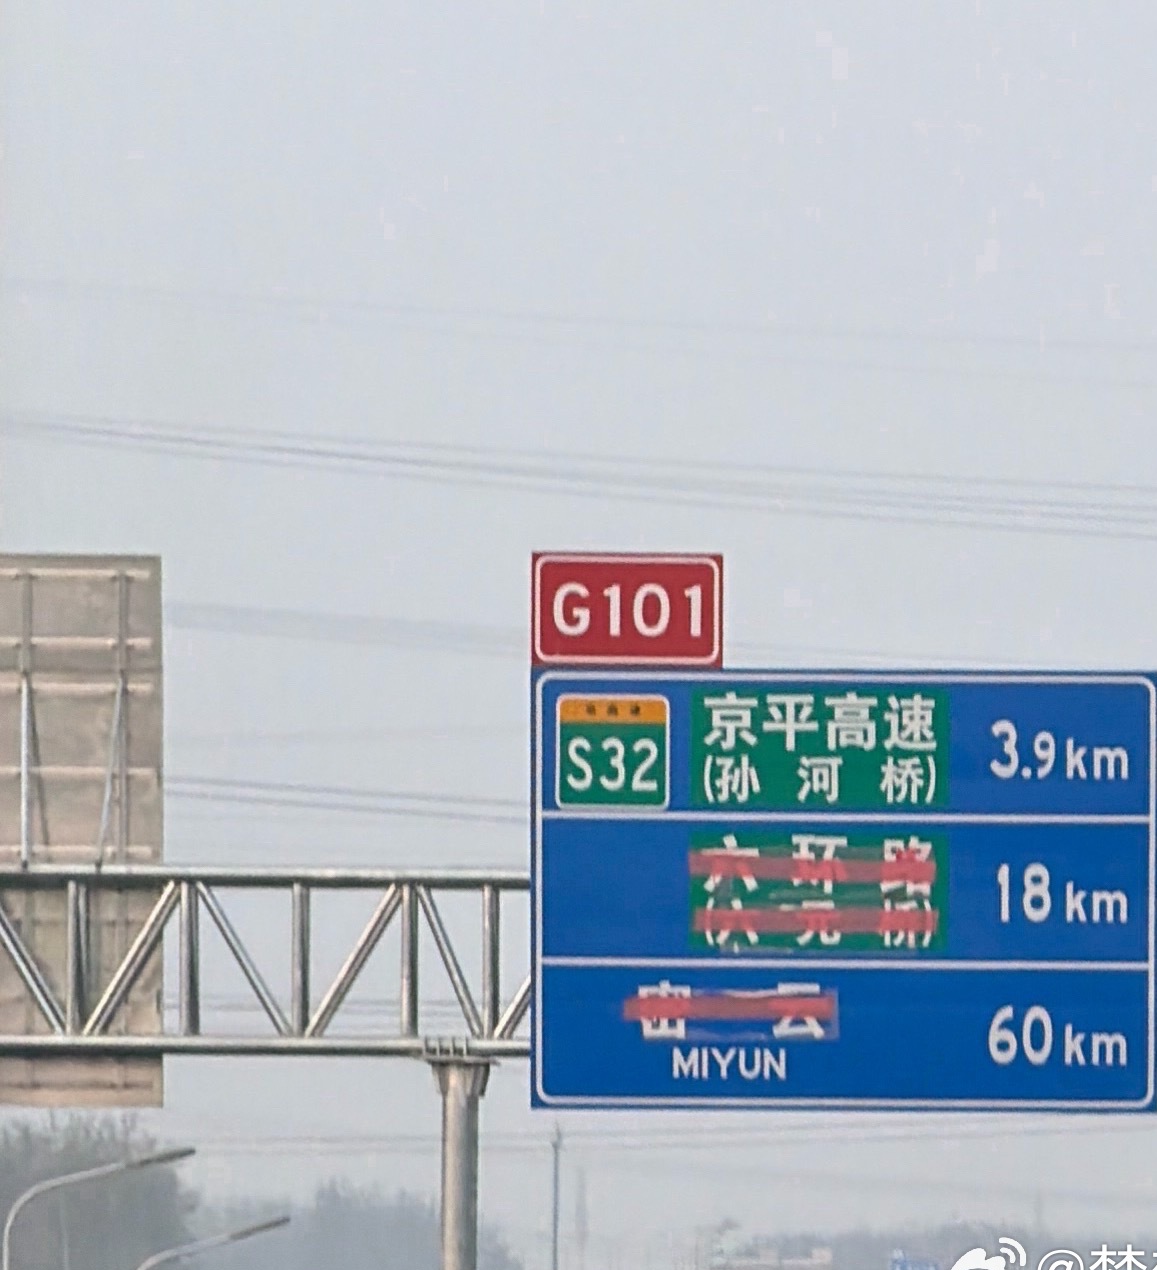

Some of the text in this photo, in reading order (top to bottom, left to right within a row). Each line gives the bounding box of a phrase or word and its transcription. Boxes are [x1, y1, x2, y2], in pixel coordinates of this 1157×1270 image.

[553, 582, 702, 638] G101
[703, 691, 937, 752] 京平高速
[566, 736, 659, 792] S32
[672, 1047, 787, 1081] MIYUN
